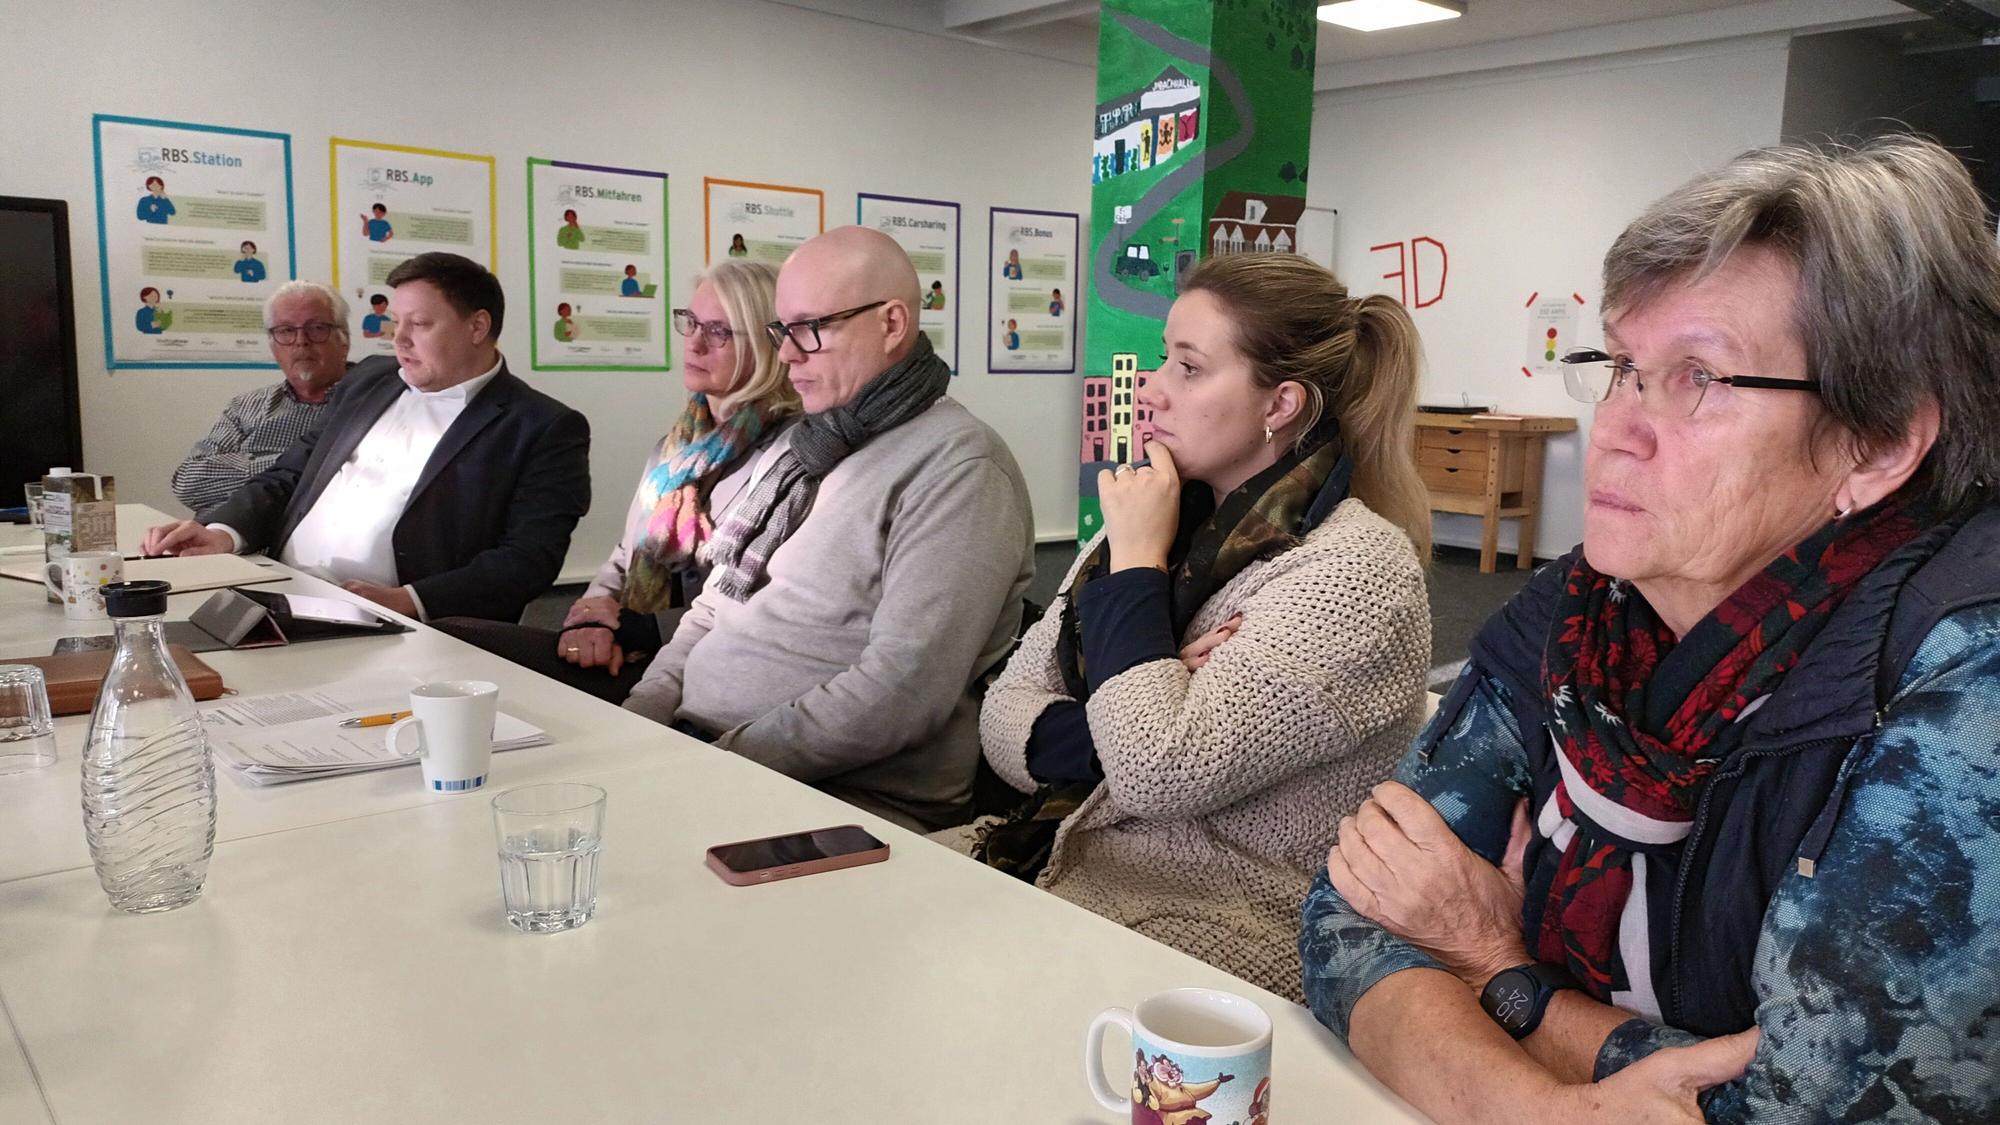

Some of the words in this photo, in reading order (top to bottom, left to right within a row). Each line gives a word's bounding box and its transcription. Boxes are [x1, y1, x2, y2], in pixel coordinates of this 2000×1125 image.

[161, 147, 242, 168] RBS.Station
[386, 168, 434, 187] RBS.App
[575, 185, 642, 203] RBS.Mitfahren
[1509, 988, 1529, 1010] 24
[1496, 1001, 1515, 1023] 10
